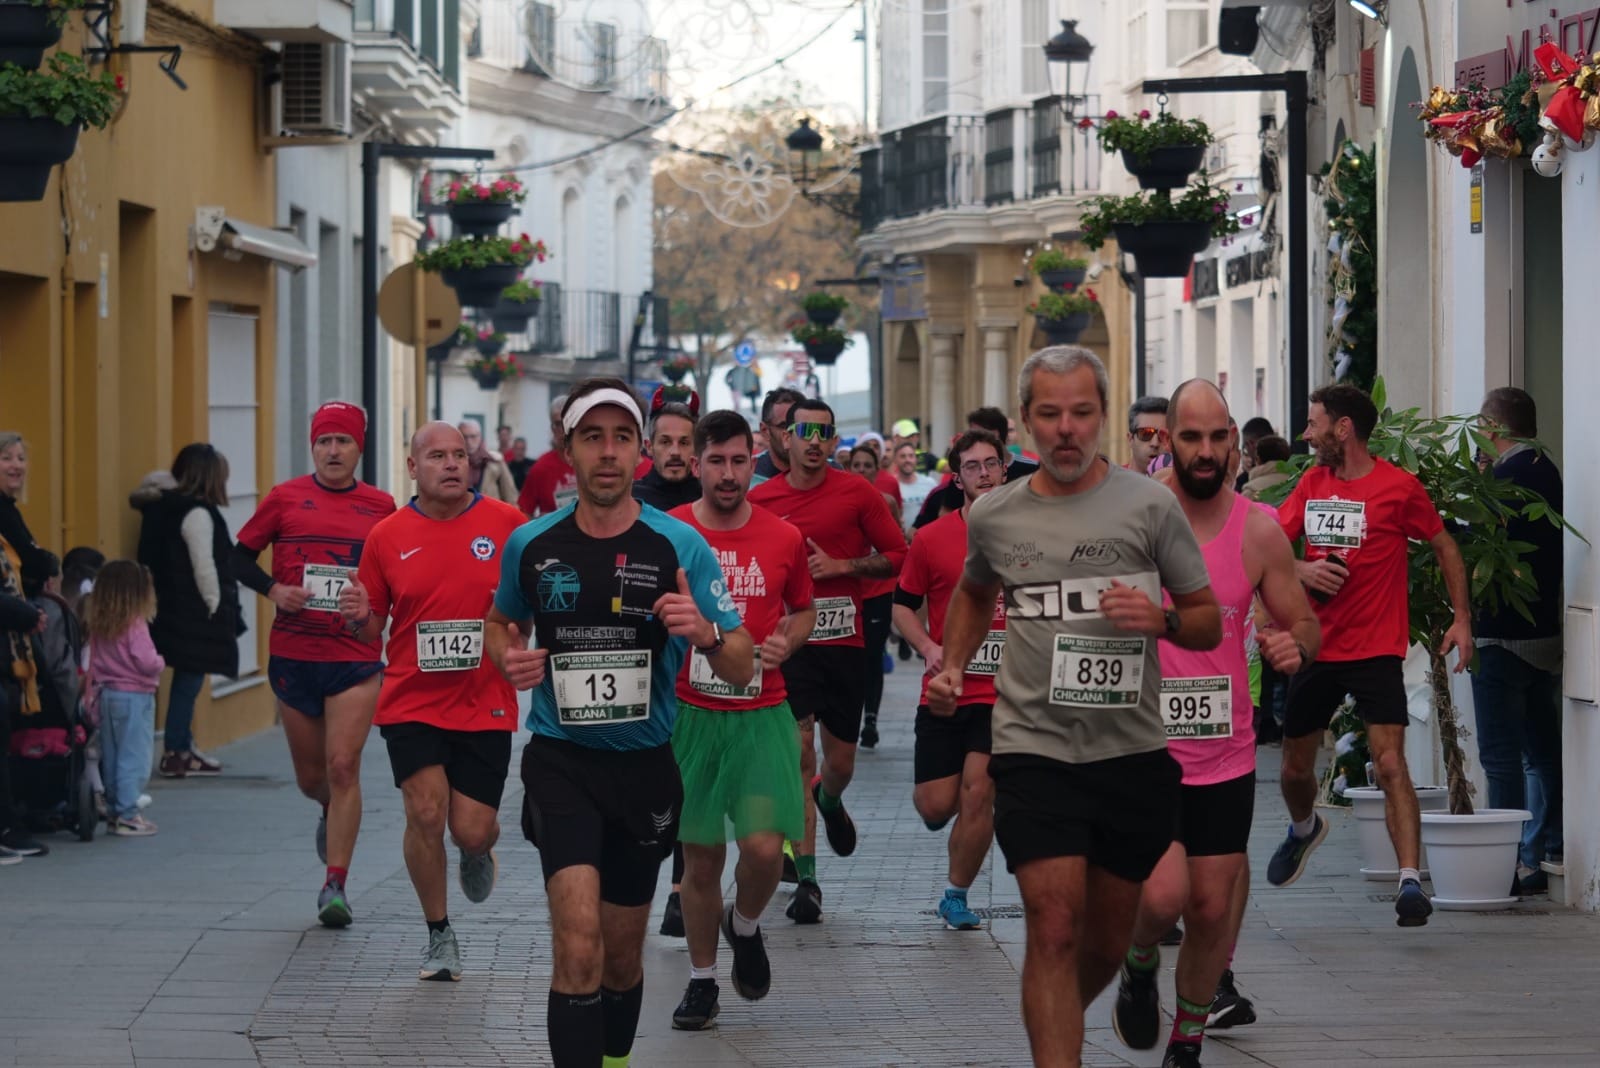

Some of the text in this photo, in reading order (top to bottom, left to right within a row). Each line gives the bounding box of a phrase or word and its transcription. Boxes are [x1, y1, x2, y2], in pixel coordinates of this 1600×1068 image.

[1318, 513, 1345, 532] 744
[428, 635, 472, 656] 1142
[1076, 639, 1107, 648] SILVESTRE
[572, 655, 602, 663] SILVESTRE
[604, 654, 647, 662] CHICLANERA
[1077, 658, 1123, 685] 839
[585, 673, 617, 701] 13
[1054, 690, 1104, 702] CHICLANA
[1169, 695, 1211, 720] 995
